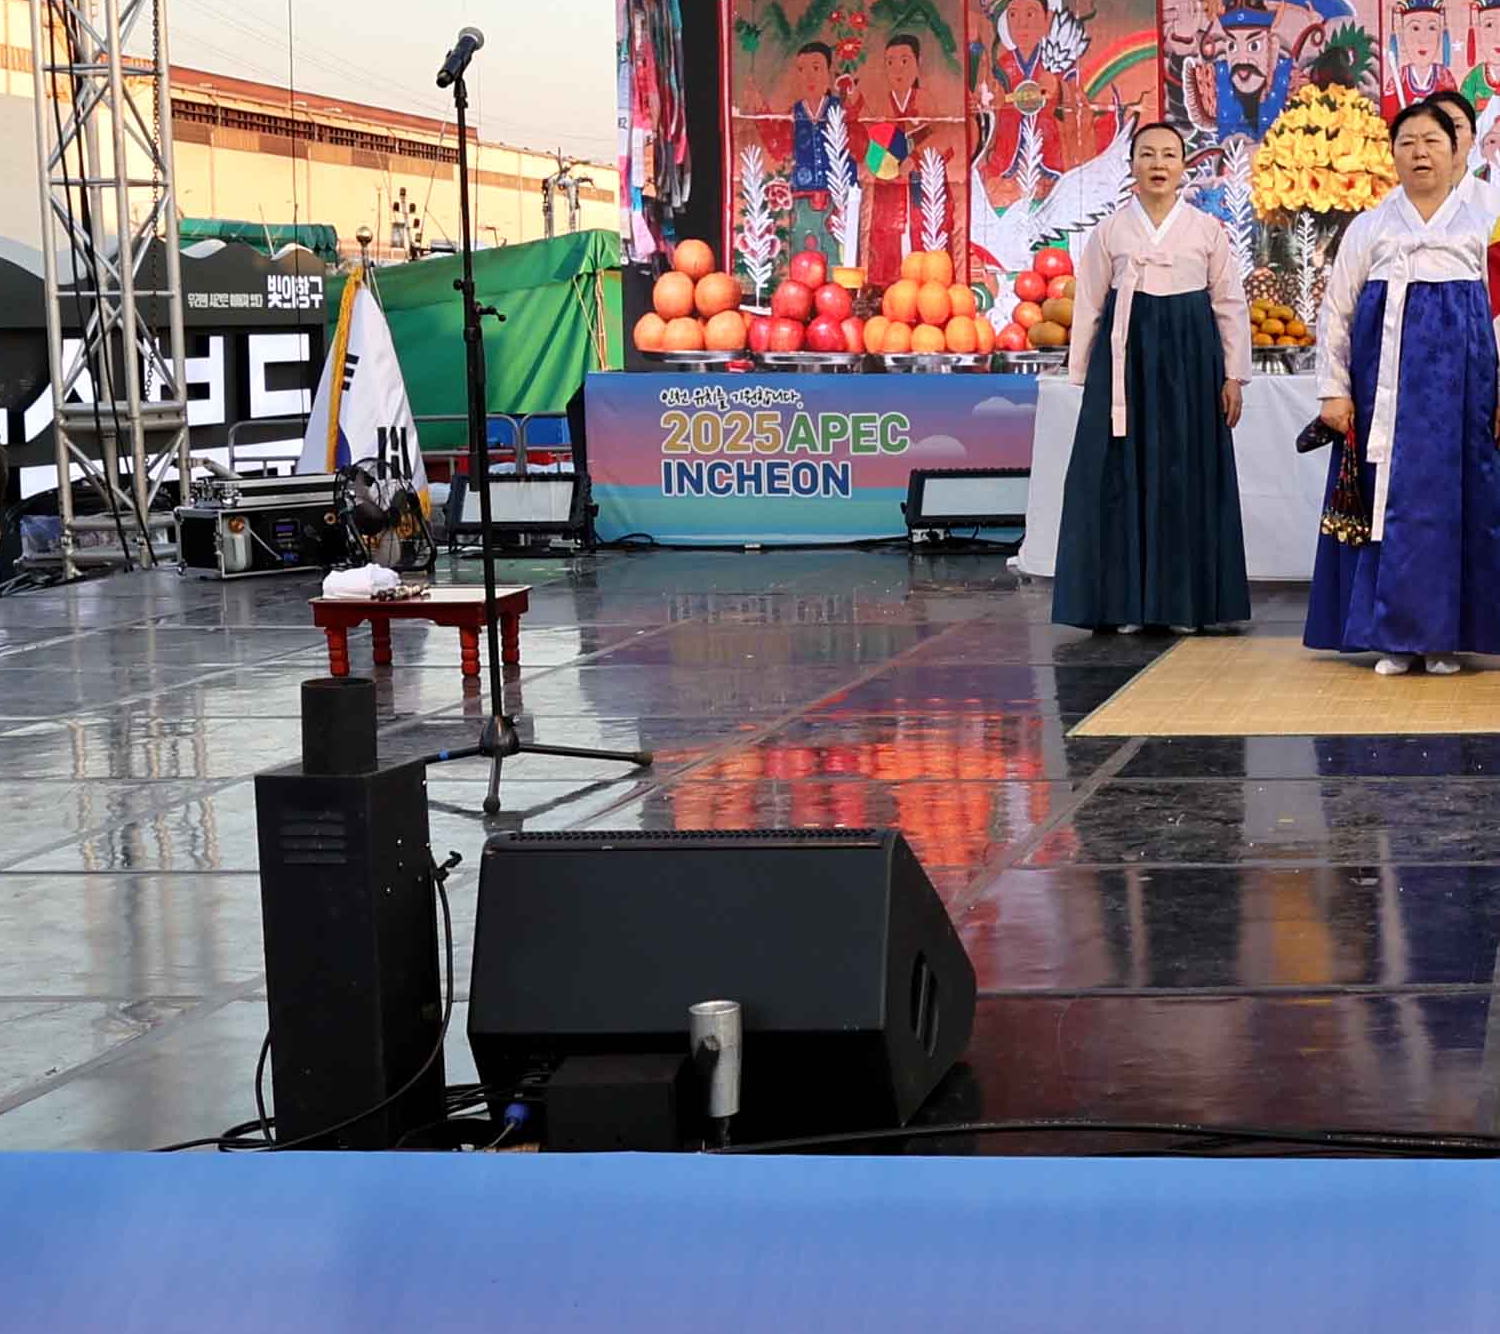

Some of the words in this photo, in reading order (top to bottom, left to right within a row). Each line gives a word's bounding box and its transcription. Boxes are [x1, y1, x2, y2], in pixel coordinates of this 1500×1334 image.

[661, 411, 784, 455] 2025
[786, 412, 911, 455] APEC
[661, 460, 852, 498] INCHEON
